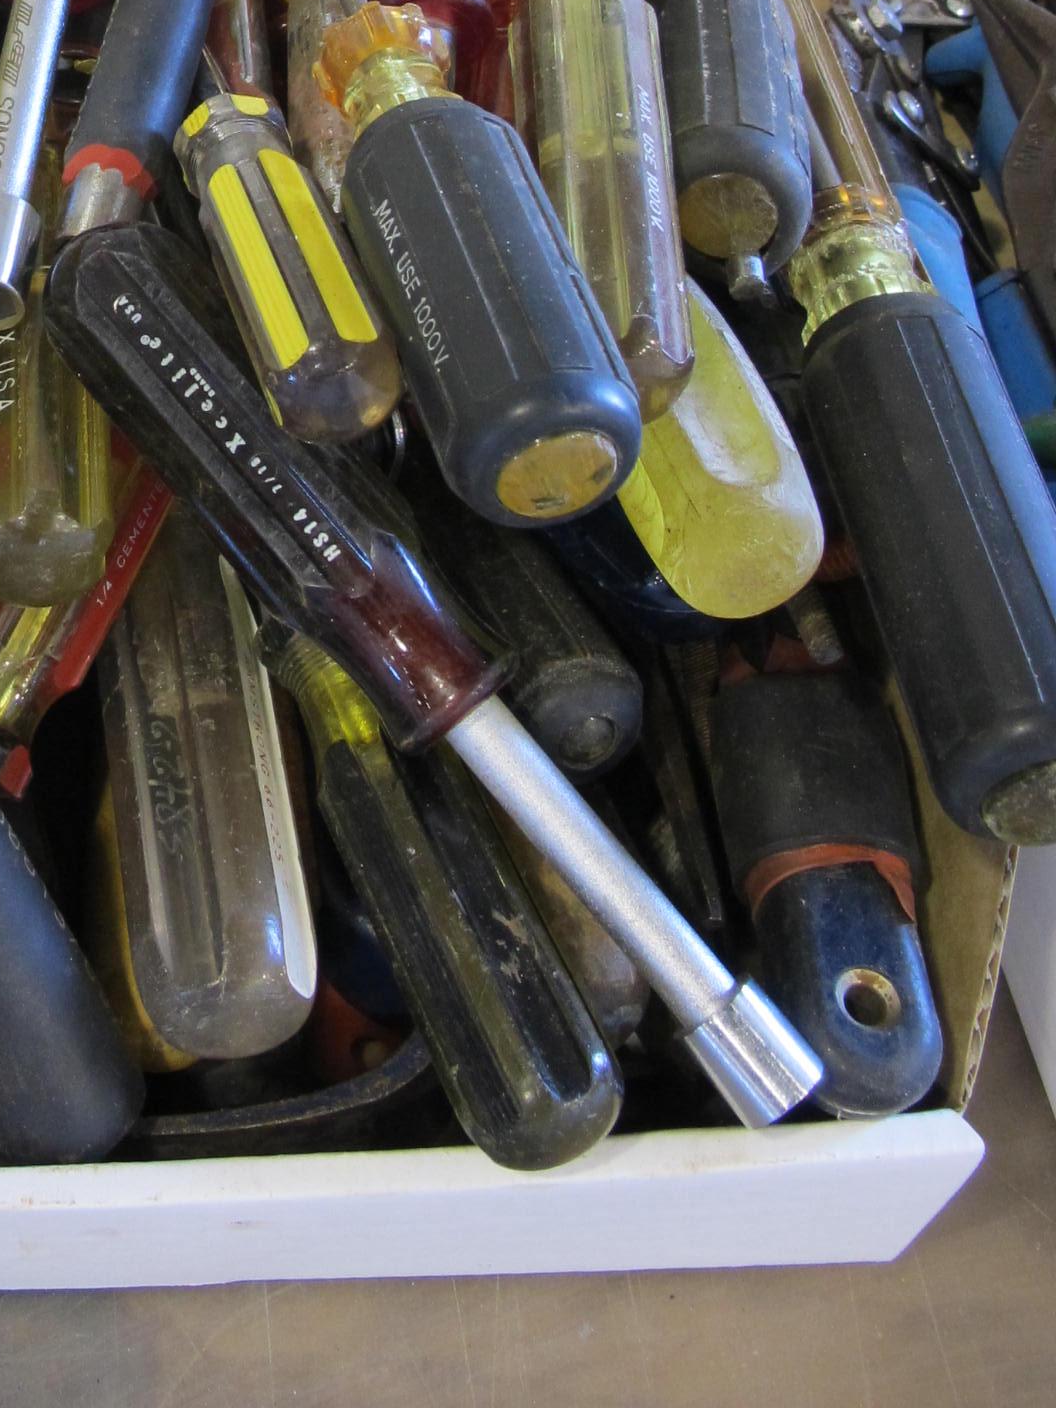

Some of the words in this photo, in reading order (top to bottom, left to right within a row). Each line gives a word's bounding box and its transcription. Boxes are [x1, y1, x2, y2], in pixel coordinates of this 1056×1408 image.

[643, 132, 658, 171] USE
[372, 198, 402, 255] MAX.
[396, 251, 421, 301] USE
[118, 294, 143, 325] USA
[293, 507, 342, 563] HS14
